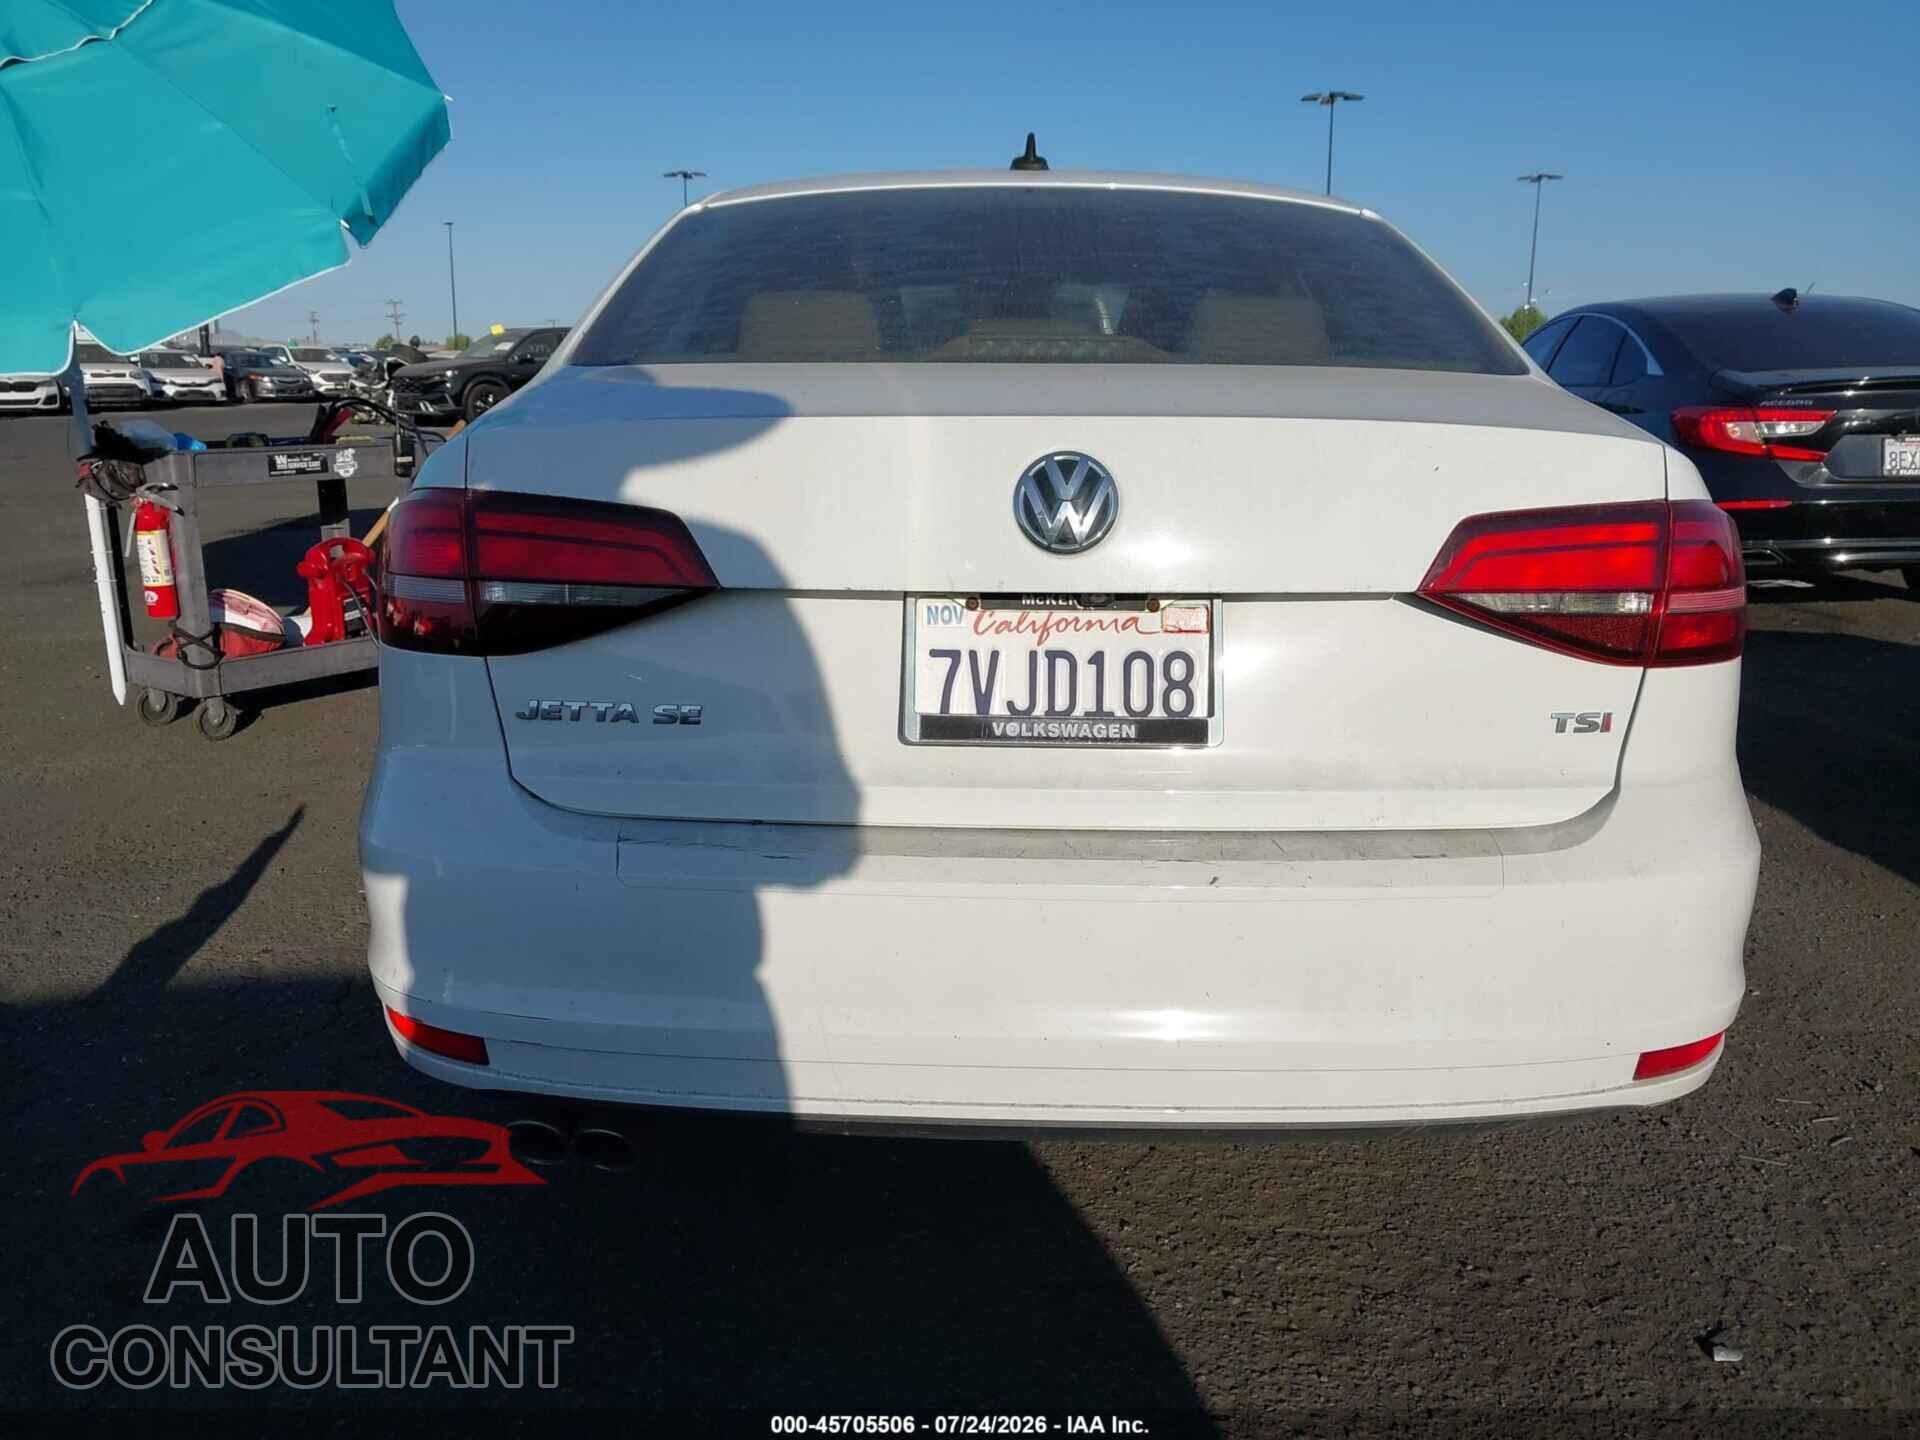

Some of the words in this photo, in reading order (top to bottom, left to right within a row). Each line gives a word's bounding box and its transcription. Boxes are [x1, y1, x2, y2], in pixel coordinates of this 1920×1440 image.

[1889, 451, 1920, 469] 8EX
[927, 605, 964, 624] NOV
[973, 610, 1160, 646] California
[929, 648, 1195, 718] 7VJD108
[515, 700, 640, 724] JETTA
[653, 704, 704, 725] SE
[1551, 712, 1613, 733] TSI
[992, 721, 1136, 738] VOLKSWAGEN
